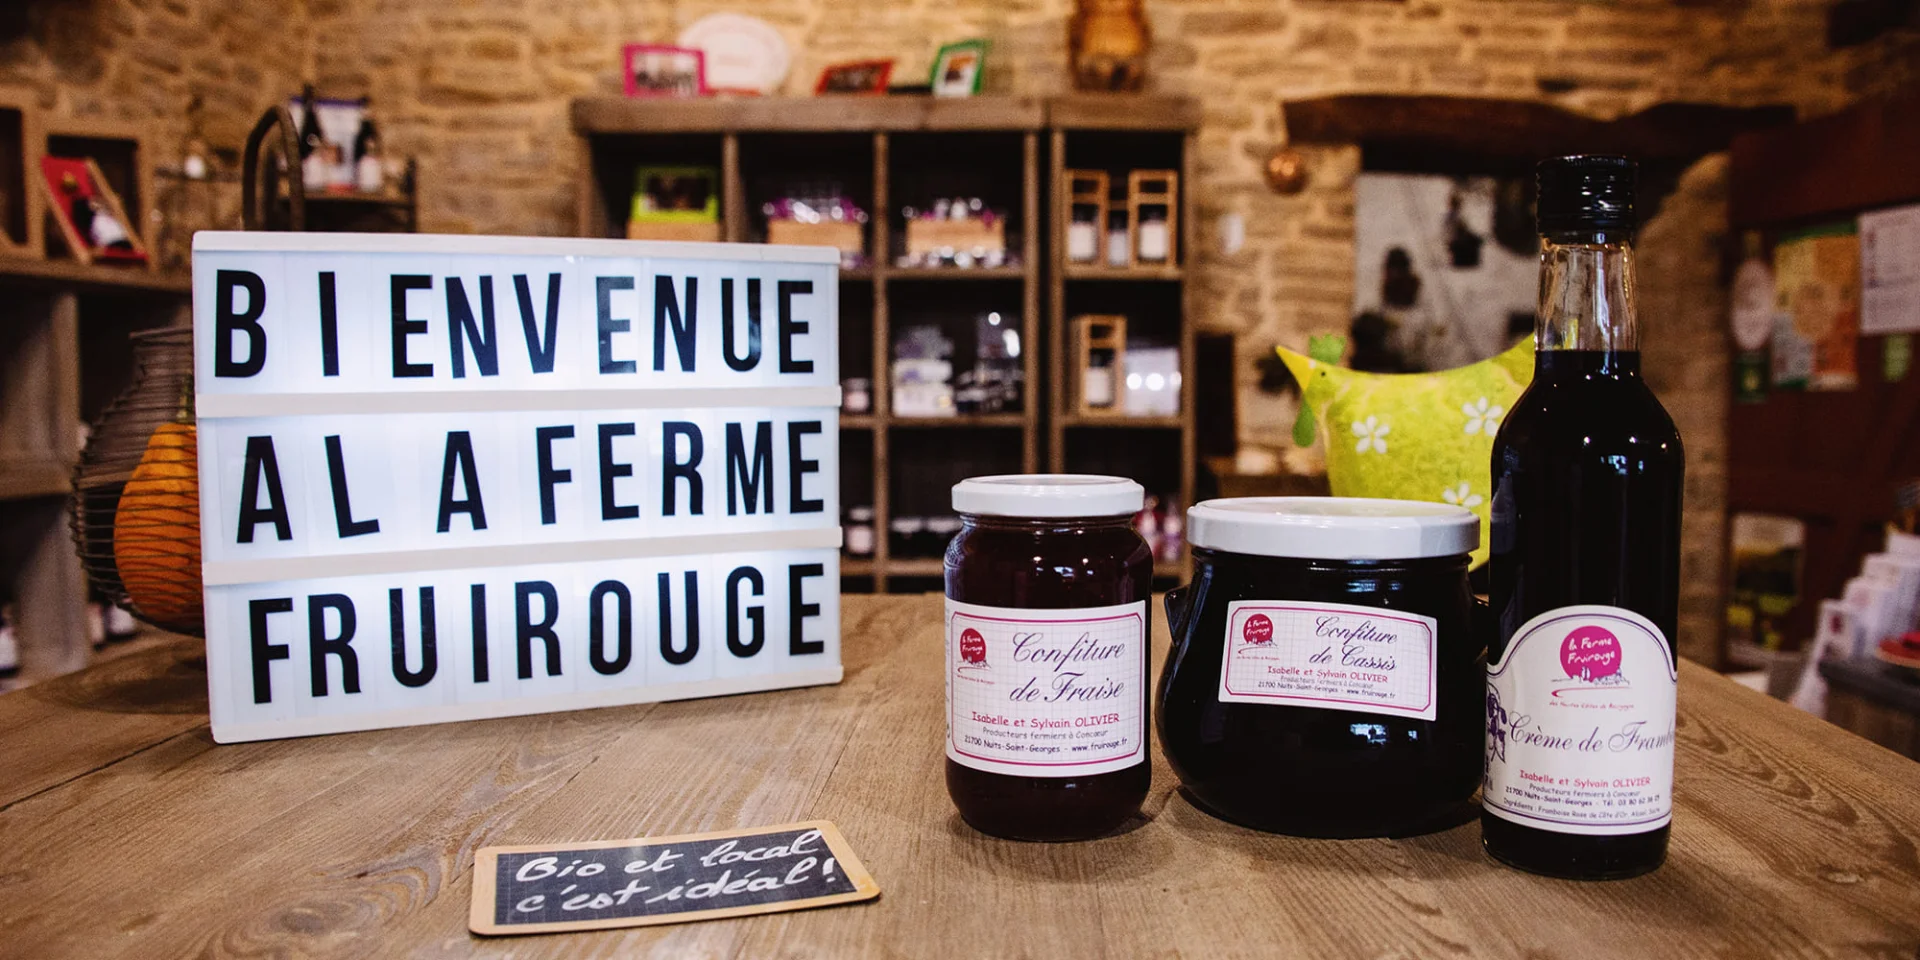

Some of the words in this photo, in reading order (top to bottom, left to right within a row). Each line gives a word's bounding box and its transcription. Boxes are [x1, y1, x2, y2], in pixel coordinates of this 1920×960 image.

[536, 420, 824, 525] FERME
[249, 562, 825, 705] FRUIROUGE
[1315, 615, 1398, 646] Confiture
[1581, 636, 1612, 650] Ferme
[1012, 631, 1125, 673] Confiture
[1309, 646, 1333, 665] de
[1341, 644, 1397, 671] Cassis
[1567, 650, 1616, 666] Fruirouge
[1009, 676, 1040, 703] de
[1044, 671, 1125, 703] Fraise
[1268, 665, 1300, 676] Isabelle
[1317, 669, 1347, 679] Sylvain
[1350, 671, 1388, 683] OLIVIER
[972, 711, 1009, 726] Isabelle
[1013, 718, 1026, 727] et
[1030, 718, 1070, 731] Sylvain
[1074, 712, 1120, 728] OLIVIER
[982, 726, 1028, 739] Producteurs
[1030, 731, 1066, 740] fermiers
[1068, 730, 1074, 739] à
[1508, 711, 1574, 750] Crème
[1578, 726, 1604, 752] de
[964, 734, 983, 746] 21700
[1519, 769, 1554, 784] Isabelle
[1558, 777, 1569, 785] et
[1573, 777, 1609, 789] Sylvain
[1612, 776, 1651, 788] OLIVIER
[1529, 782, 1571, 796] Producteurs
[1573, 789, 1605, 798] fermiers
[515, 856, 606, 882] Bio
[623, 849, 684, 873] et
[700, 829, 823, 867] local
[515, 879, 651, 913] c'est
